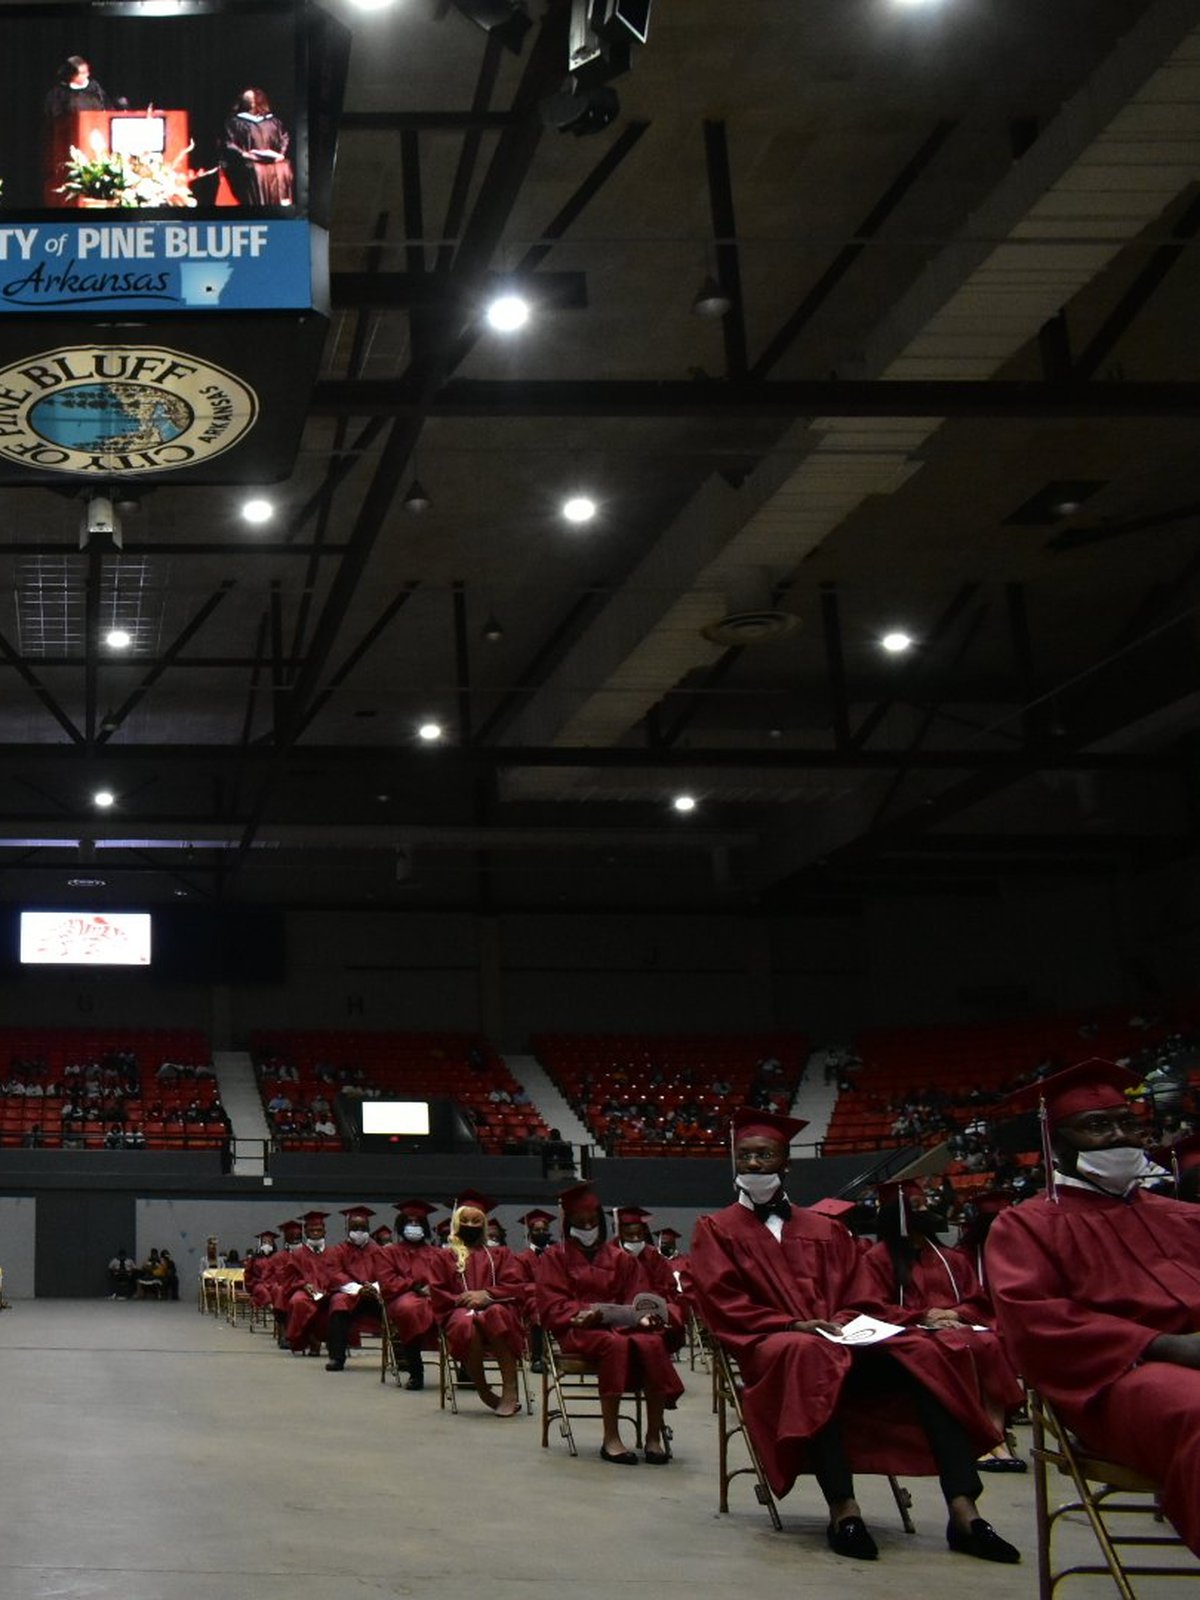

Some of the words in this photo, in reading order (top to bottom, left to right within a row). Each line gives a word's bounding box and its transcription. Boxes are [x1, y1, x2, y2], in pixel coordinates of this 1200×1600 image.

[45, 234, 68, 257] of
[78, 227, 155, 259] PINE
[165, 225, 268, 258] BLUFF
[2, 259, 171, 297] Arkansas
[17, 354, 198, 389] BLUFF
[197, 385, 234, 444] ARKANSAS
[3, 442, 70, 465] OF
[80, 444, 196, 471] CITY
[346, 996, 364, 1016] H
